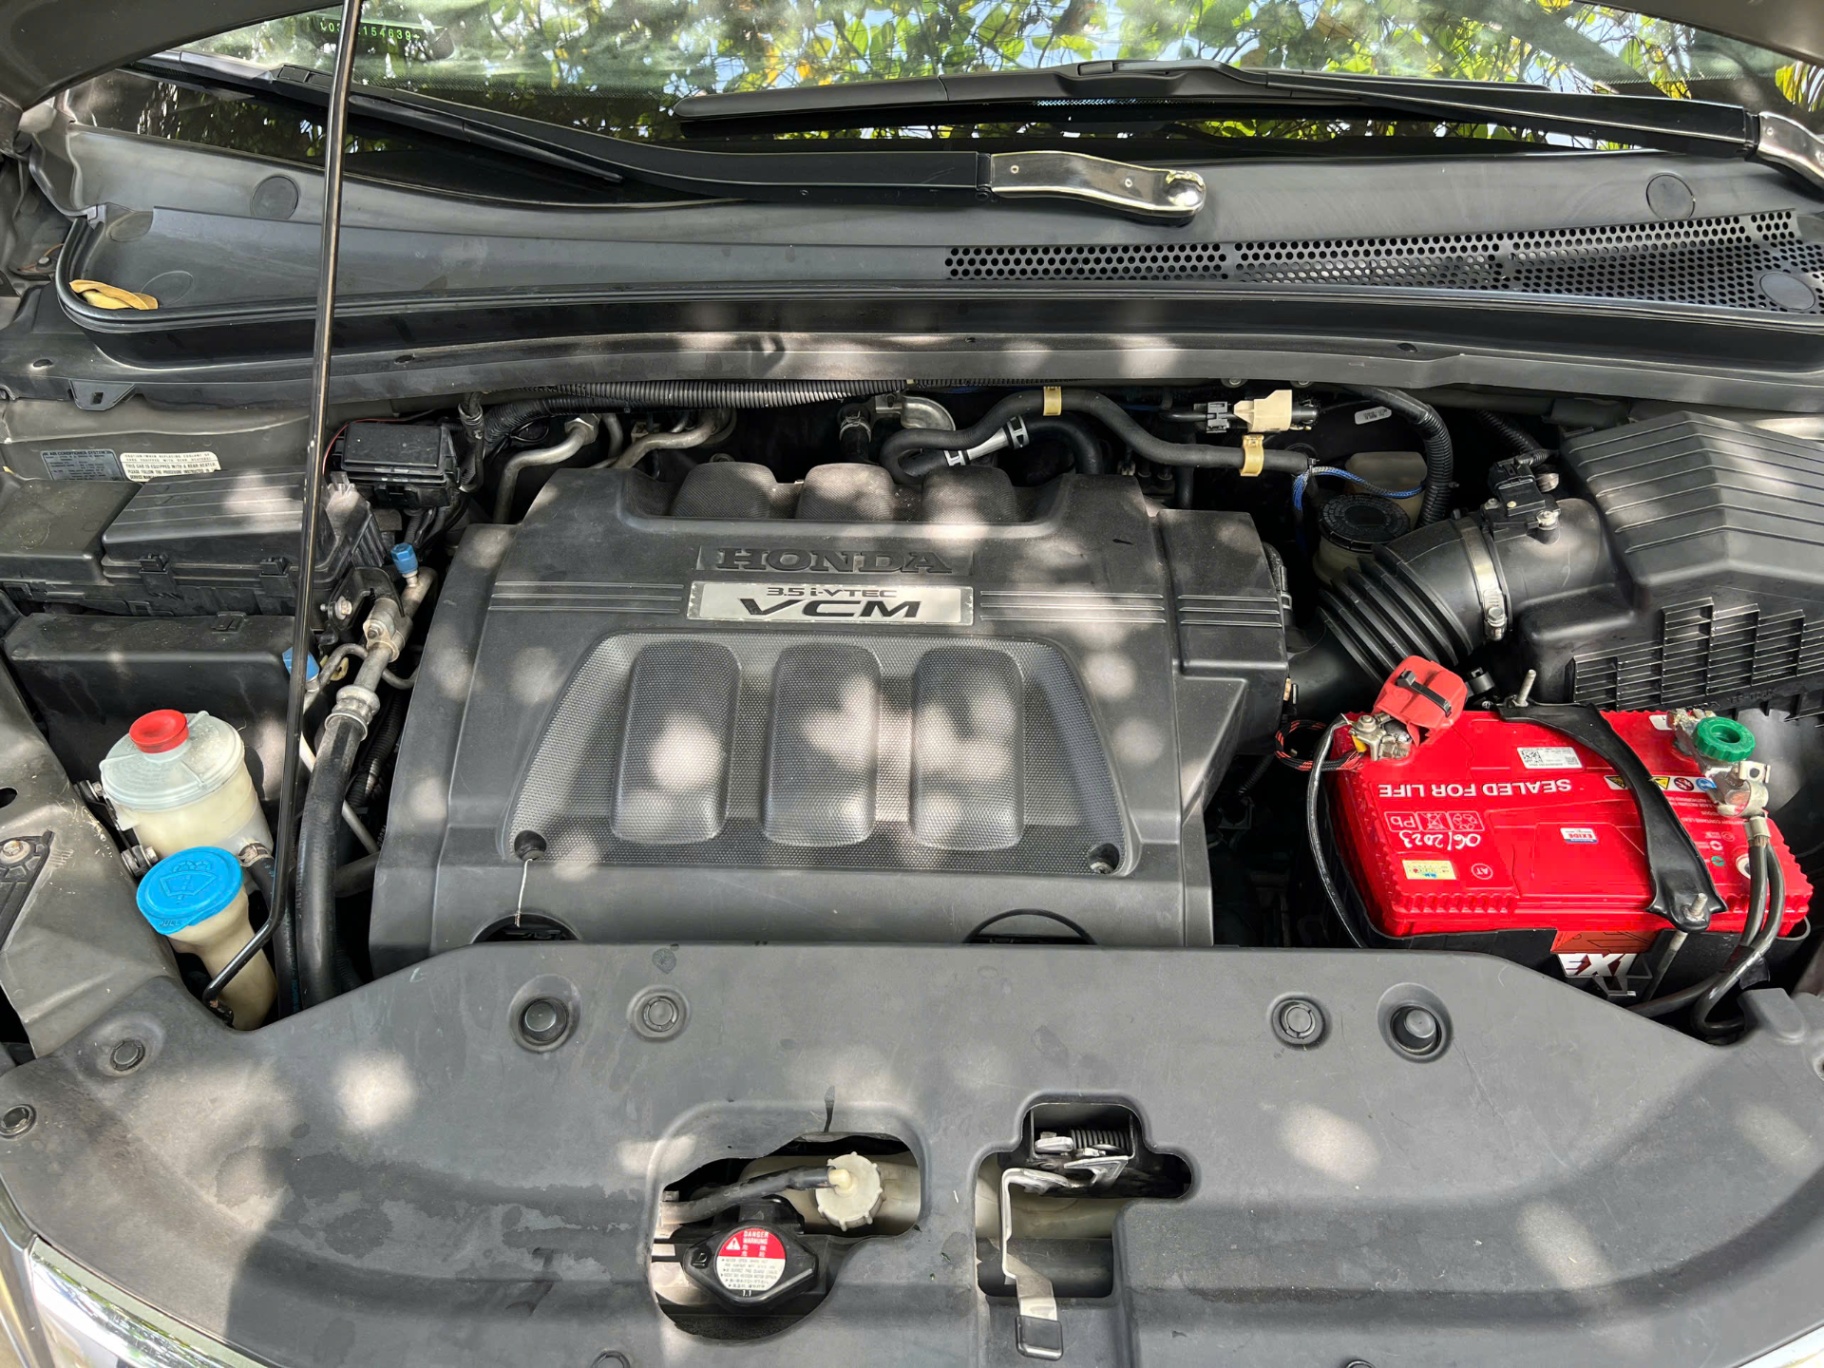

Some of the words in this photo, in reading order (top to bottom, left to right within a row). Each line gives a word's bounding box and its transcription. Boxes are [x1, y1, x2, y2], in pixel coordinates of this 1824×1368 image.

[717, 547, 953, 574] HONDA
[767, 587, 805, 598] 3.5
[739, 598, 922, 619] VCM
[1378, 784, 1425, 798] LIFE
[1431, 783, 1477, 797] FOR
[1482, 778, 1573, 796] SEALED
[1390, 816, 1416, 828] Pb
[1399, 829, 1482, 851] 06/2023
